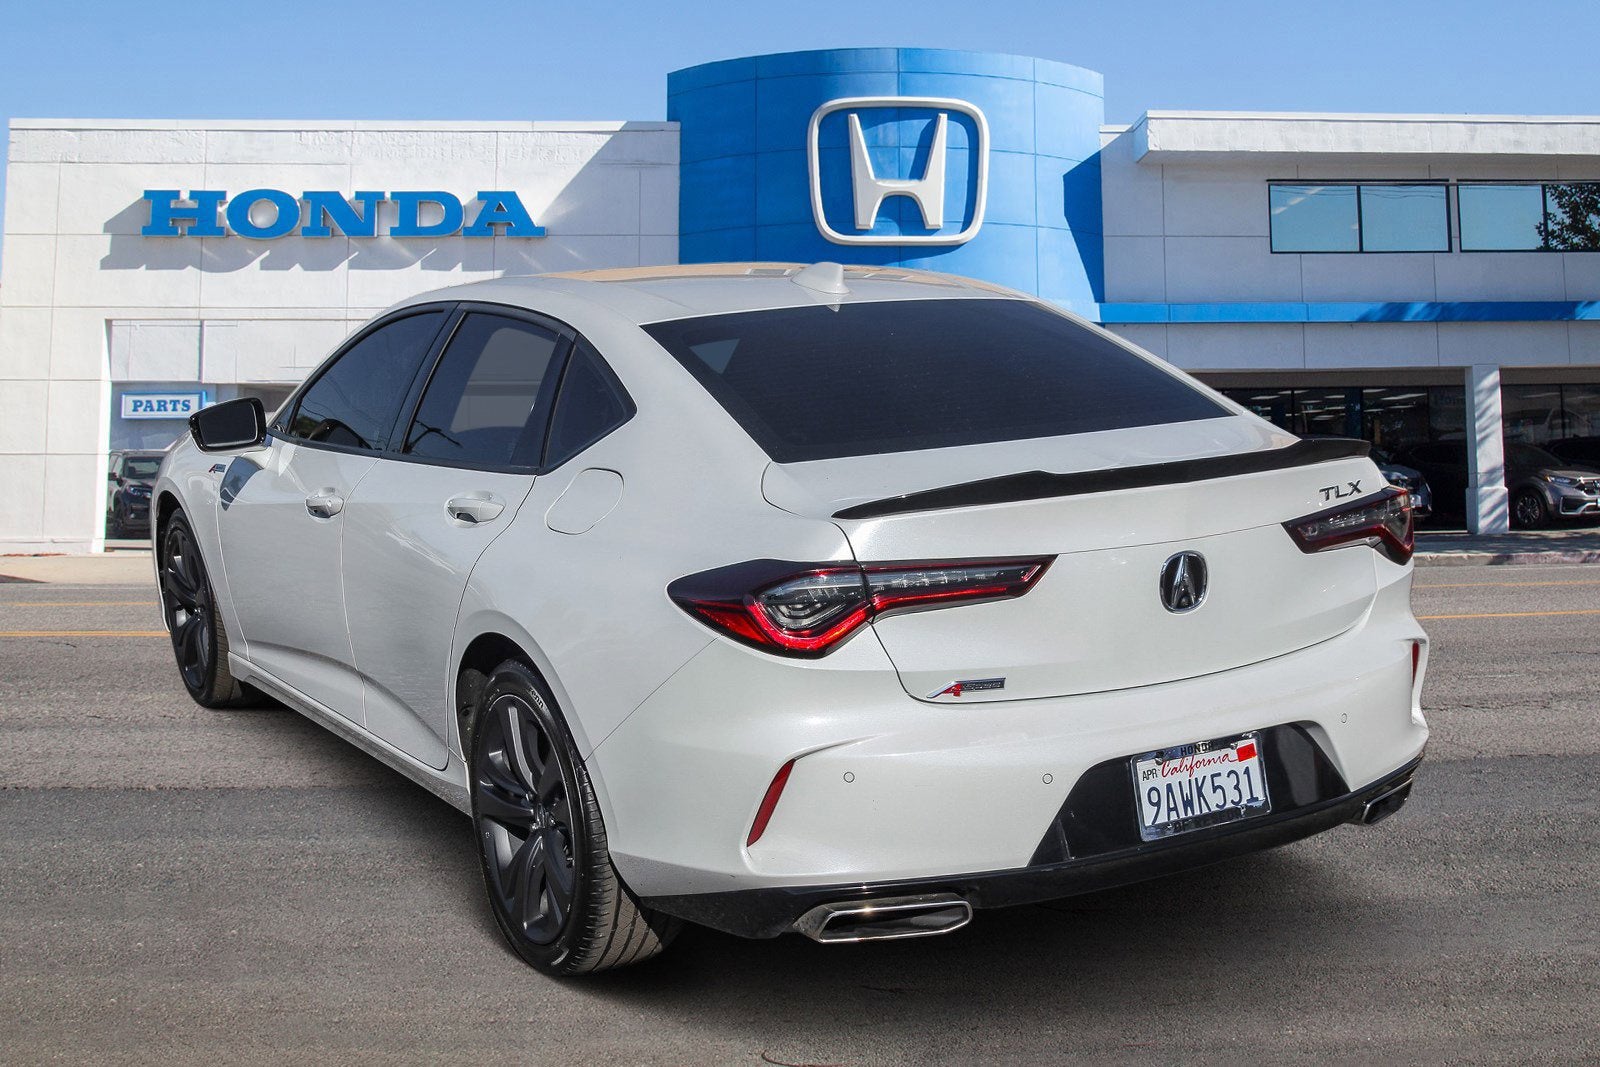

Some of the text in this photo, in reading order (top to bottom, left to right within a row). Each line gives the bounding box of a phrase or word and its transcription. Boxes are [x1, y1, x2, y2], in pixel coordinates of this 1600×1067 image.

[141, 188, 547, 239] HONDA
[131, 399, 192, 413] PARTS
[1319, 480, 1362, 501] TLX
[1142, 768, 1158, 781] APR
[1161, 753, 1237, 778] California
[1147, 766, 1259, 826] 9AWK531
